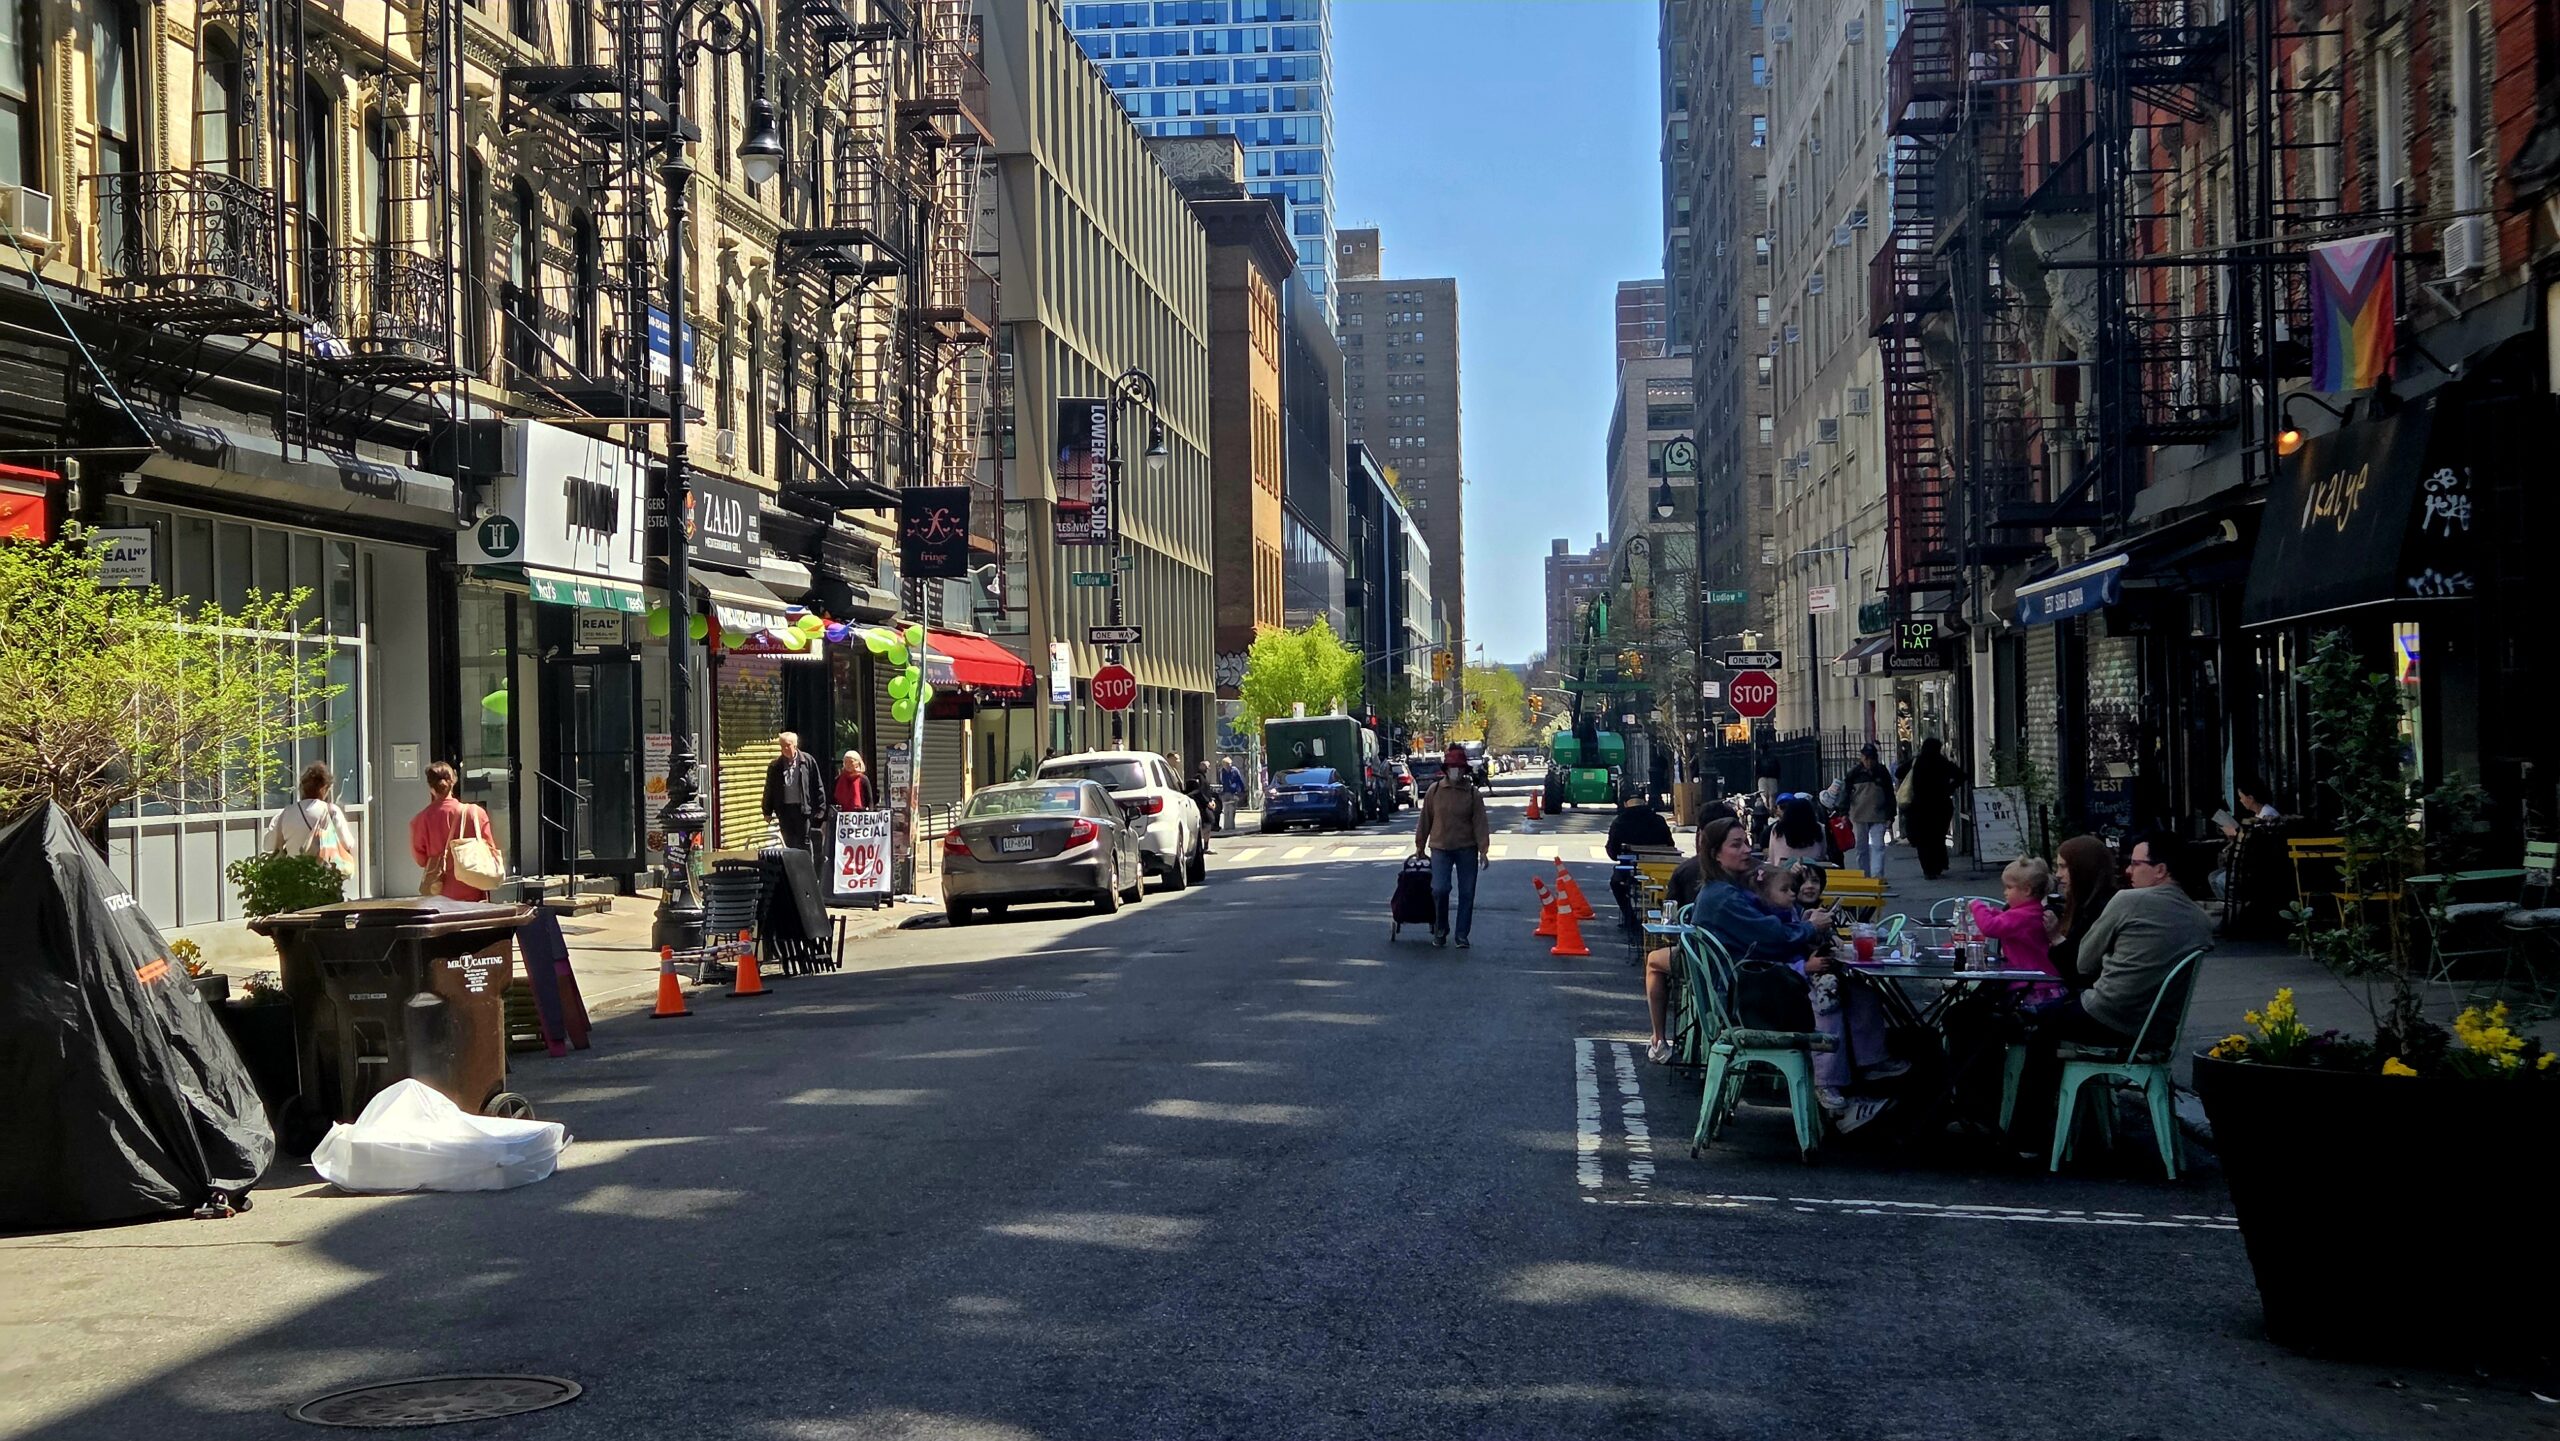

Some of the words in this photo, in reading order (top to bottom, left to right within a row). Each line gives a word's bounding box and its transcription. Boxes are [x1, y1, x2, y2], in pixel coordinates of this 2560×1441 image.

[1091, 405, 1106, 458] LOWER
[1091, 463, 1106, 502] EAST
[647, 498, 666, 510] GERS
[703, 490, 742, 538] ZAAD
[1091, 505, 1106, 538] SIDE
[920, 551, 948, 565] fringe
[1076, 573, 1100, 585] Ludlow
[1712, 591, 1736, 602] Ludlow
[1095, 631, 1112, 640] ONE
[1117, 631, 1135, 640] WAY
[1901, 623, 1934, 637] TOP
[1902, 636, 1933, 649] HAT
[1732, 656, 1749, 665] ONE
[1756, 656, 1774, 665] WAY
[1889, 654, 1923, 668] Gourmet
[1094, 678, 1133, 699] STOP
[1733, 685, 1774, 704] STOP
[2093, 779, 2124, 792] ZEST
[838, 811, 890, 827] RE-OPENING
[1994, 810, 2010, 820] HAT
[839, 826, 888, 839] SPECIAL
[842, 844, 884, 876] 20%
[847, 877, 878, 889] OFF
[472, 956, 503, 967] CARTING
